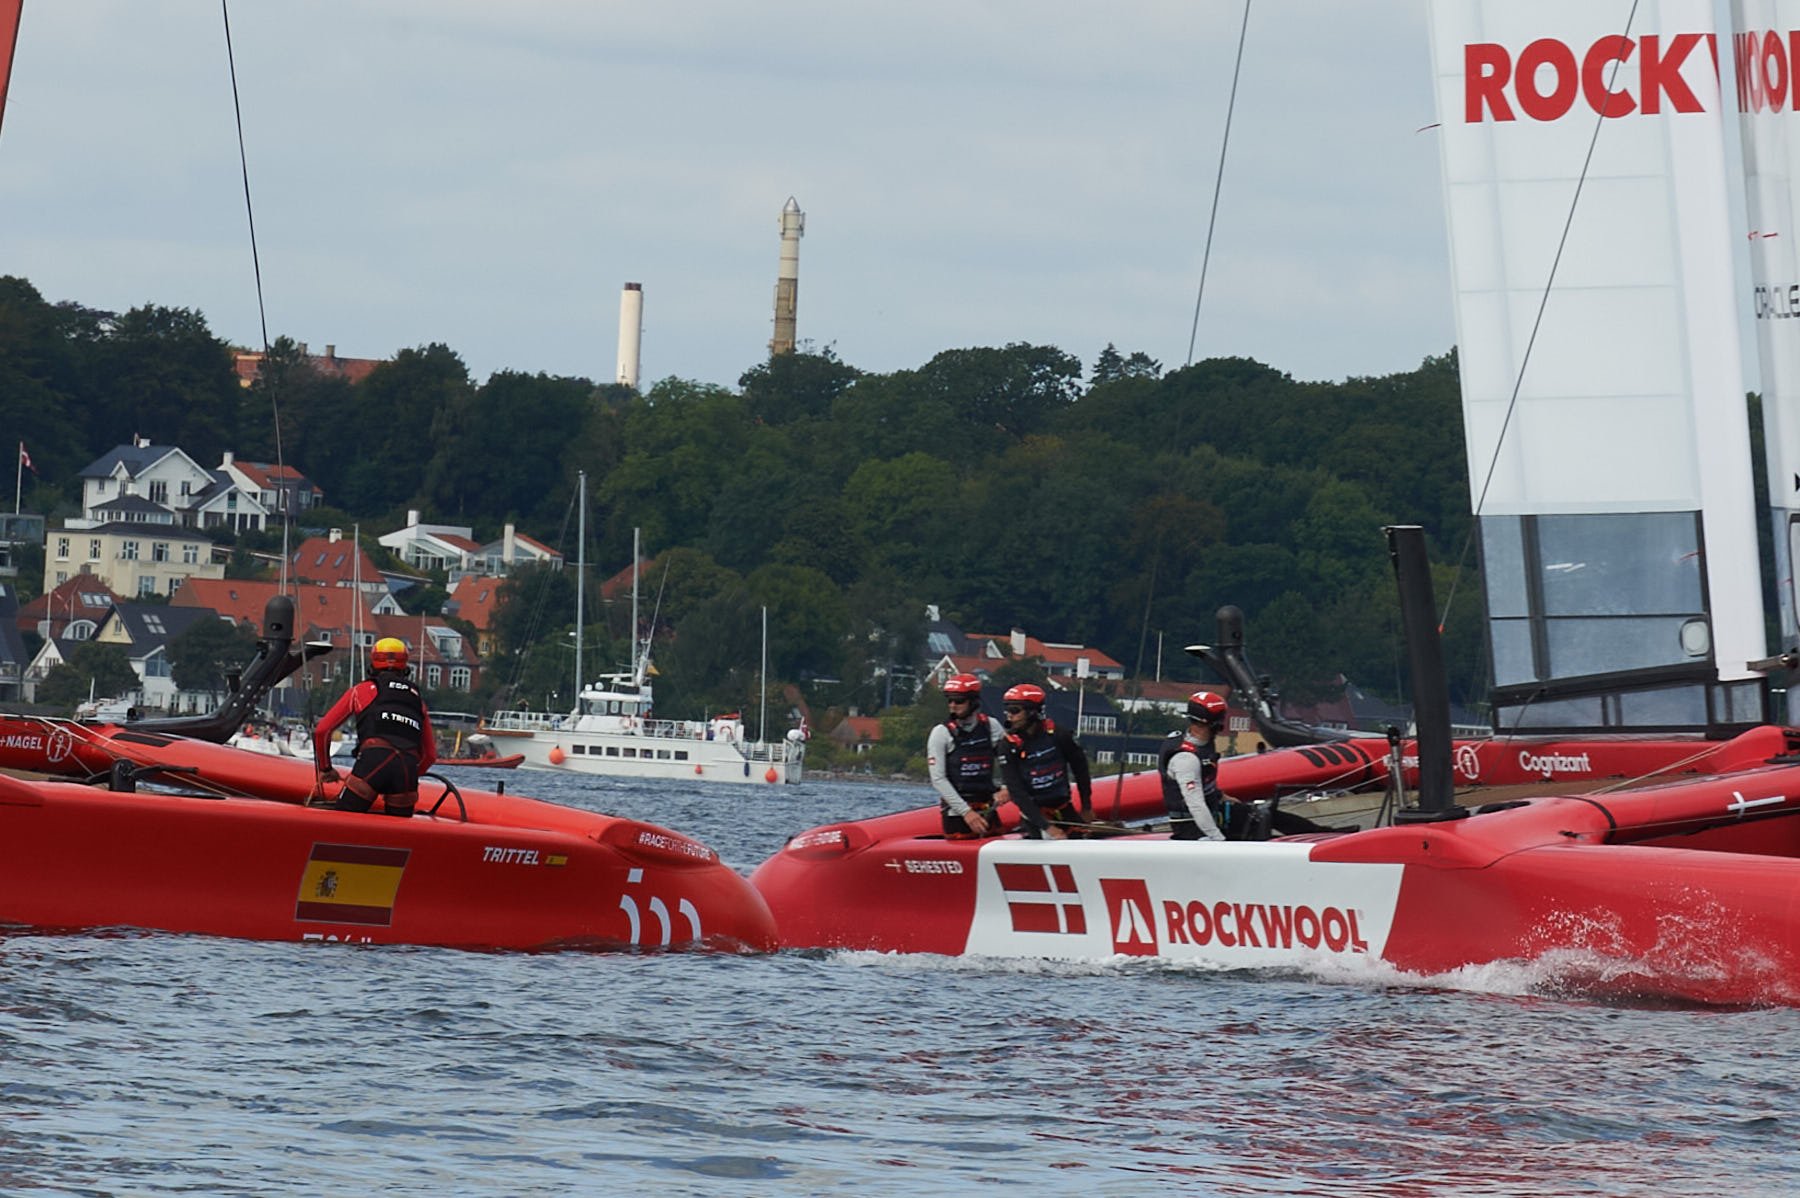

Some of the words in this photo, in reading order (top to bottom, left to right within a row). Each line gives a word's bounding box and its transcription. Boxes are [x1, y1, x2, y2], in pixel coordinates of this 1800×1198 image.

[391, 713, 421, 731] TRITTEL
[1519, 750, 1592, 778] Cognizant
[482, 846, 540, 865] TRITTEL
[904, 859, 964, 874] SEHESTED
[1162, 900, 1368, 954] ROCKWOOL
